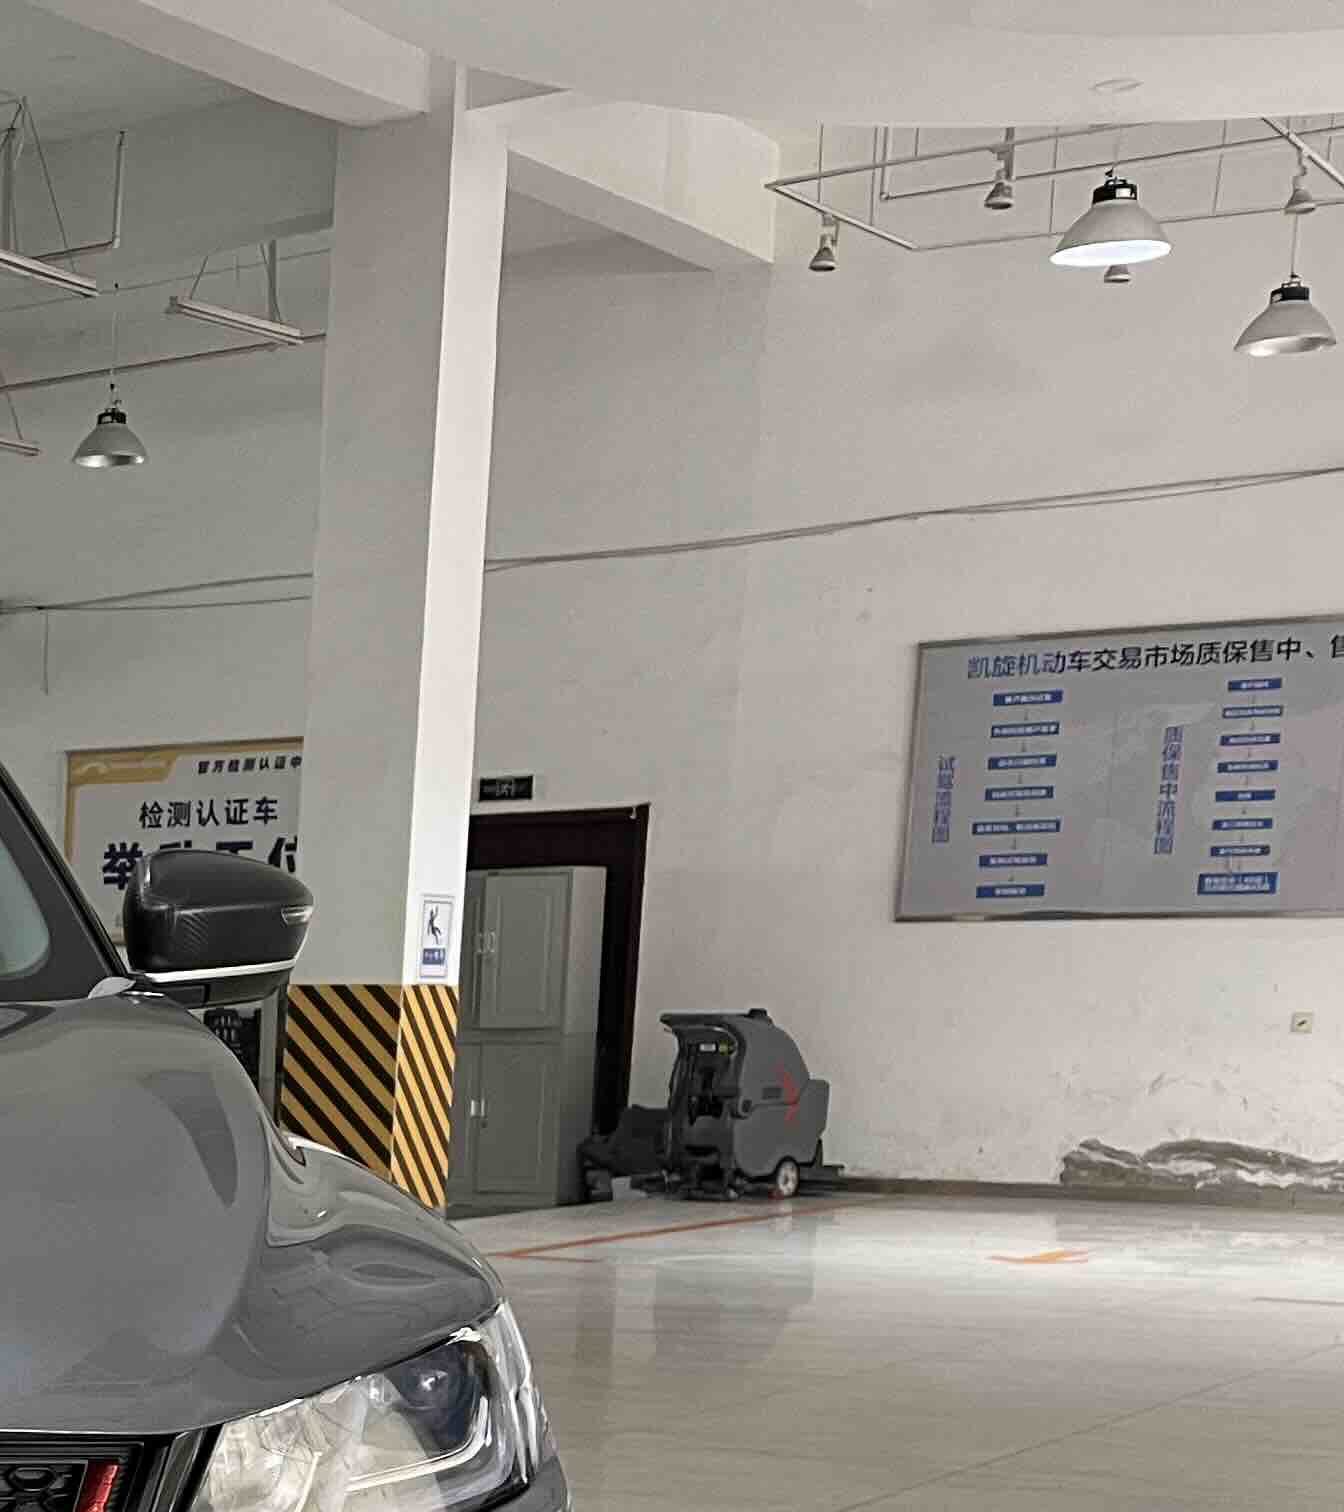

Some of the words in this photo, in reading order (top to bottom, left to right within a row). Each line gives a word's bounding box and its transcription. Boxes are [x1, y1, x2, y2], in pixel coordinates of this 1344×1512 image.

[138, 796, 279, 829] 检测认证车
